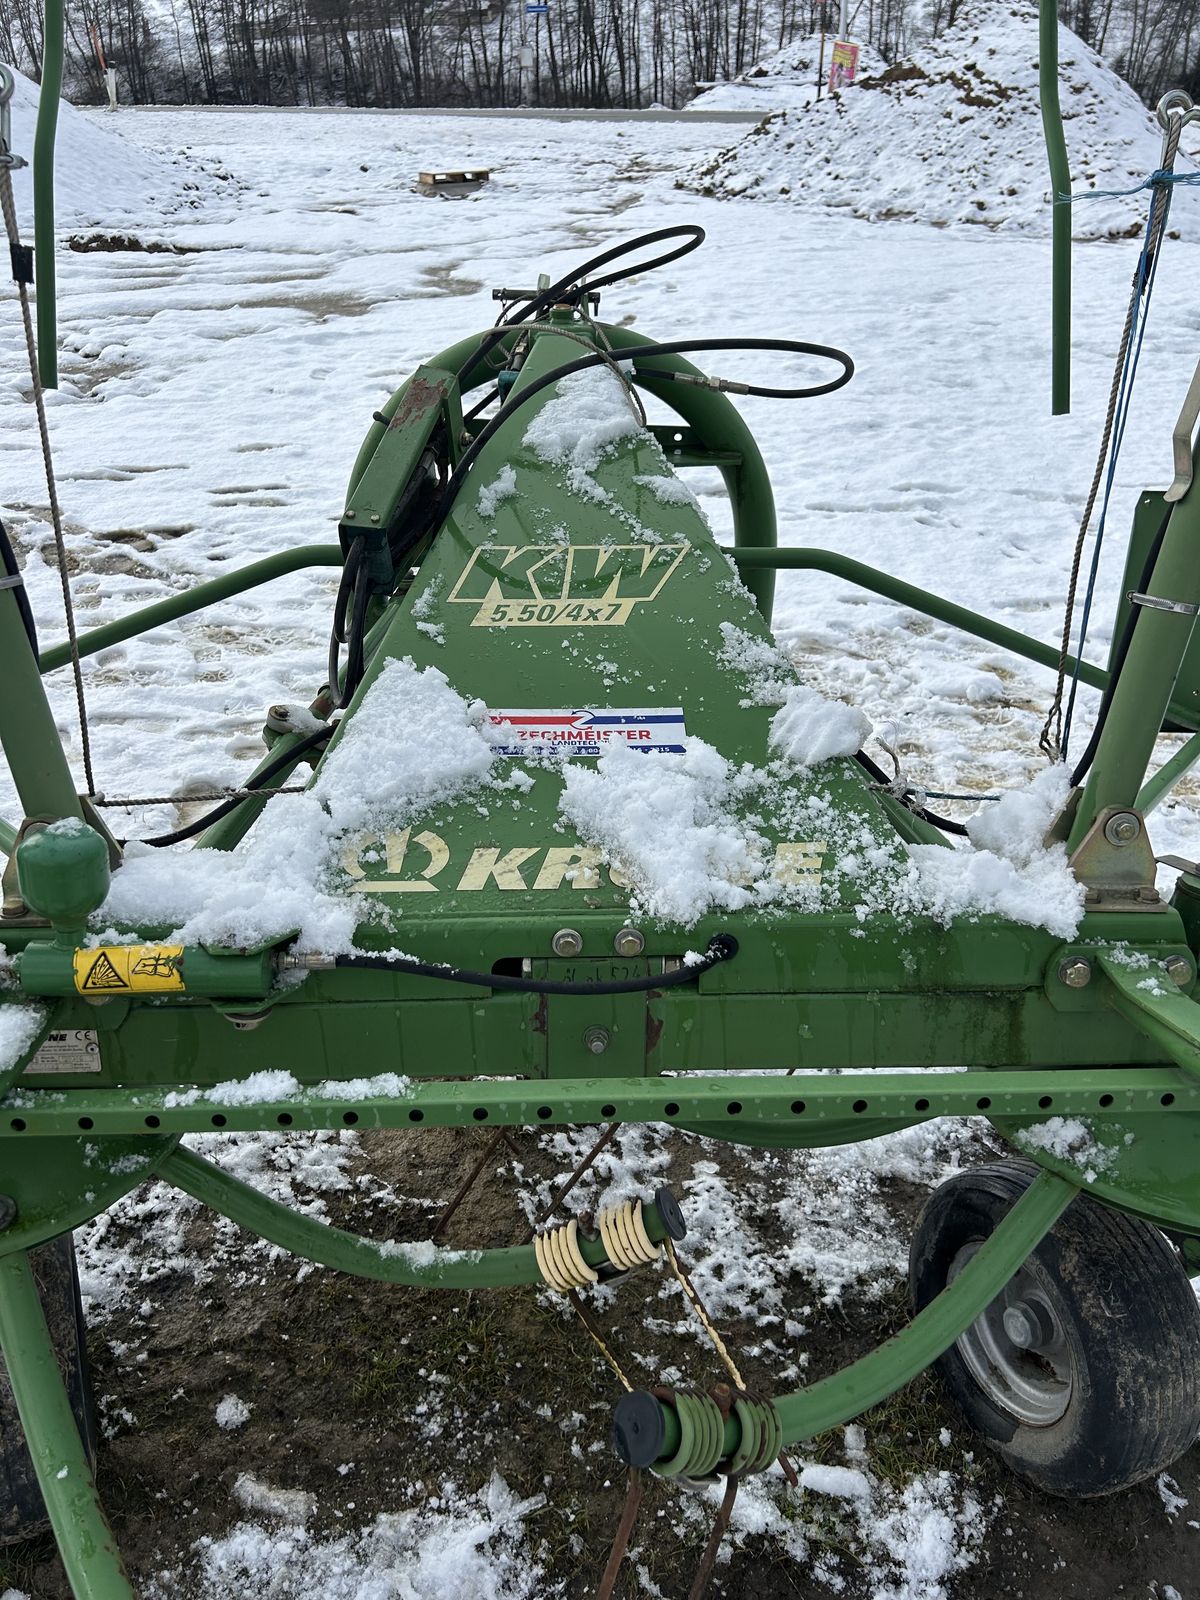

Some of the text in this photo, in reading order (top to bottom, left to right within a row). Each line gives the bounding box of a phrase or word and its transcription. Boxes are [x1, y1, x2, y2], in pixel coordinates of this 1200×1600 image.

[447, 543, 692, 602] KW
[490, 603, 622, 623] 5.50/4x7
[456, 842, 827, 890] KRE
